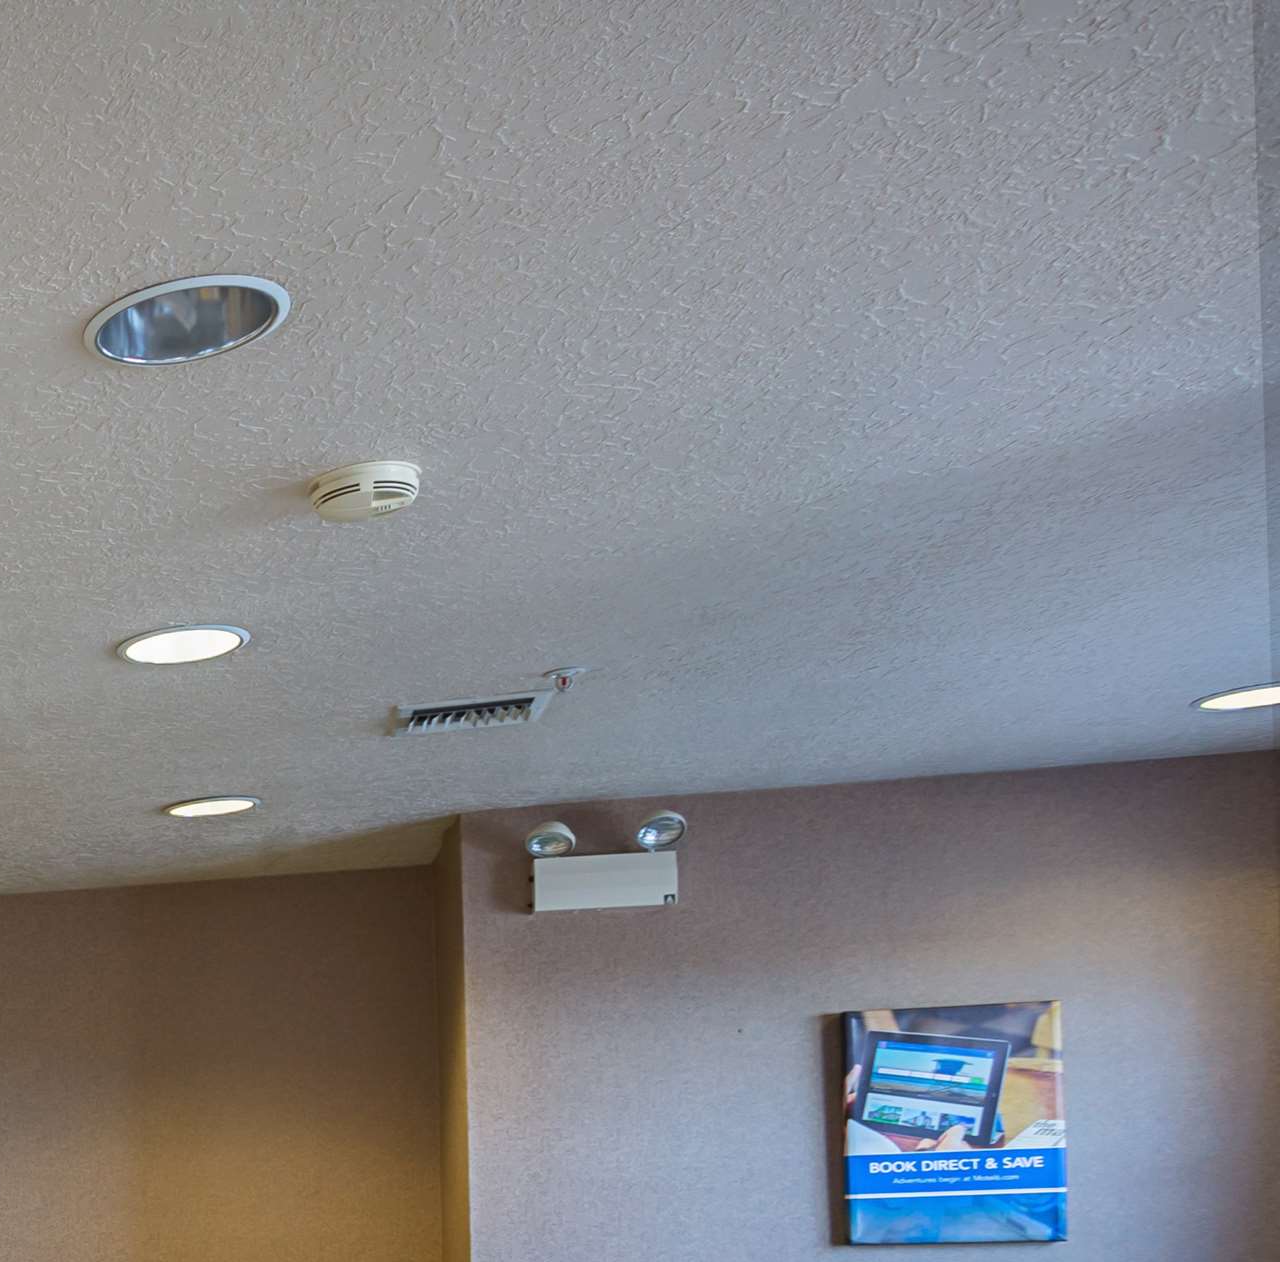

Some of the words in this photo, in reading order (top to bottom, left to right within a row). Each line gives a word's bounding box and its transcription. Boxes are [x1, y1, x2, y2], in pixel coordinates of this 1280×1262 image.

[868, 1161, 917, 1174] BOOK
[921, 1158, 981, 1172] DIRECT
[984, 1157, 998, 1170] &
[1002, 1155, 1045, 1169] SAVE
